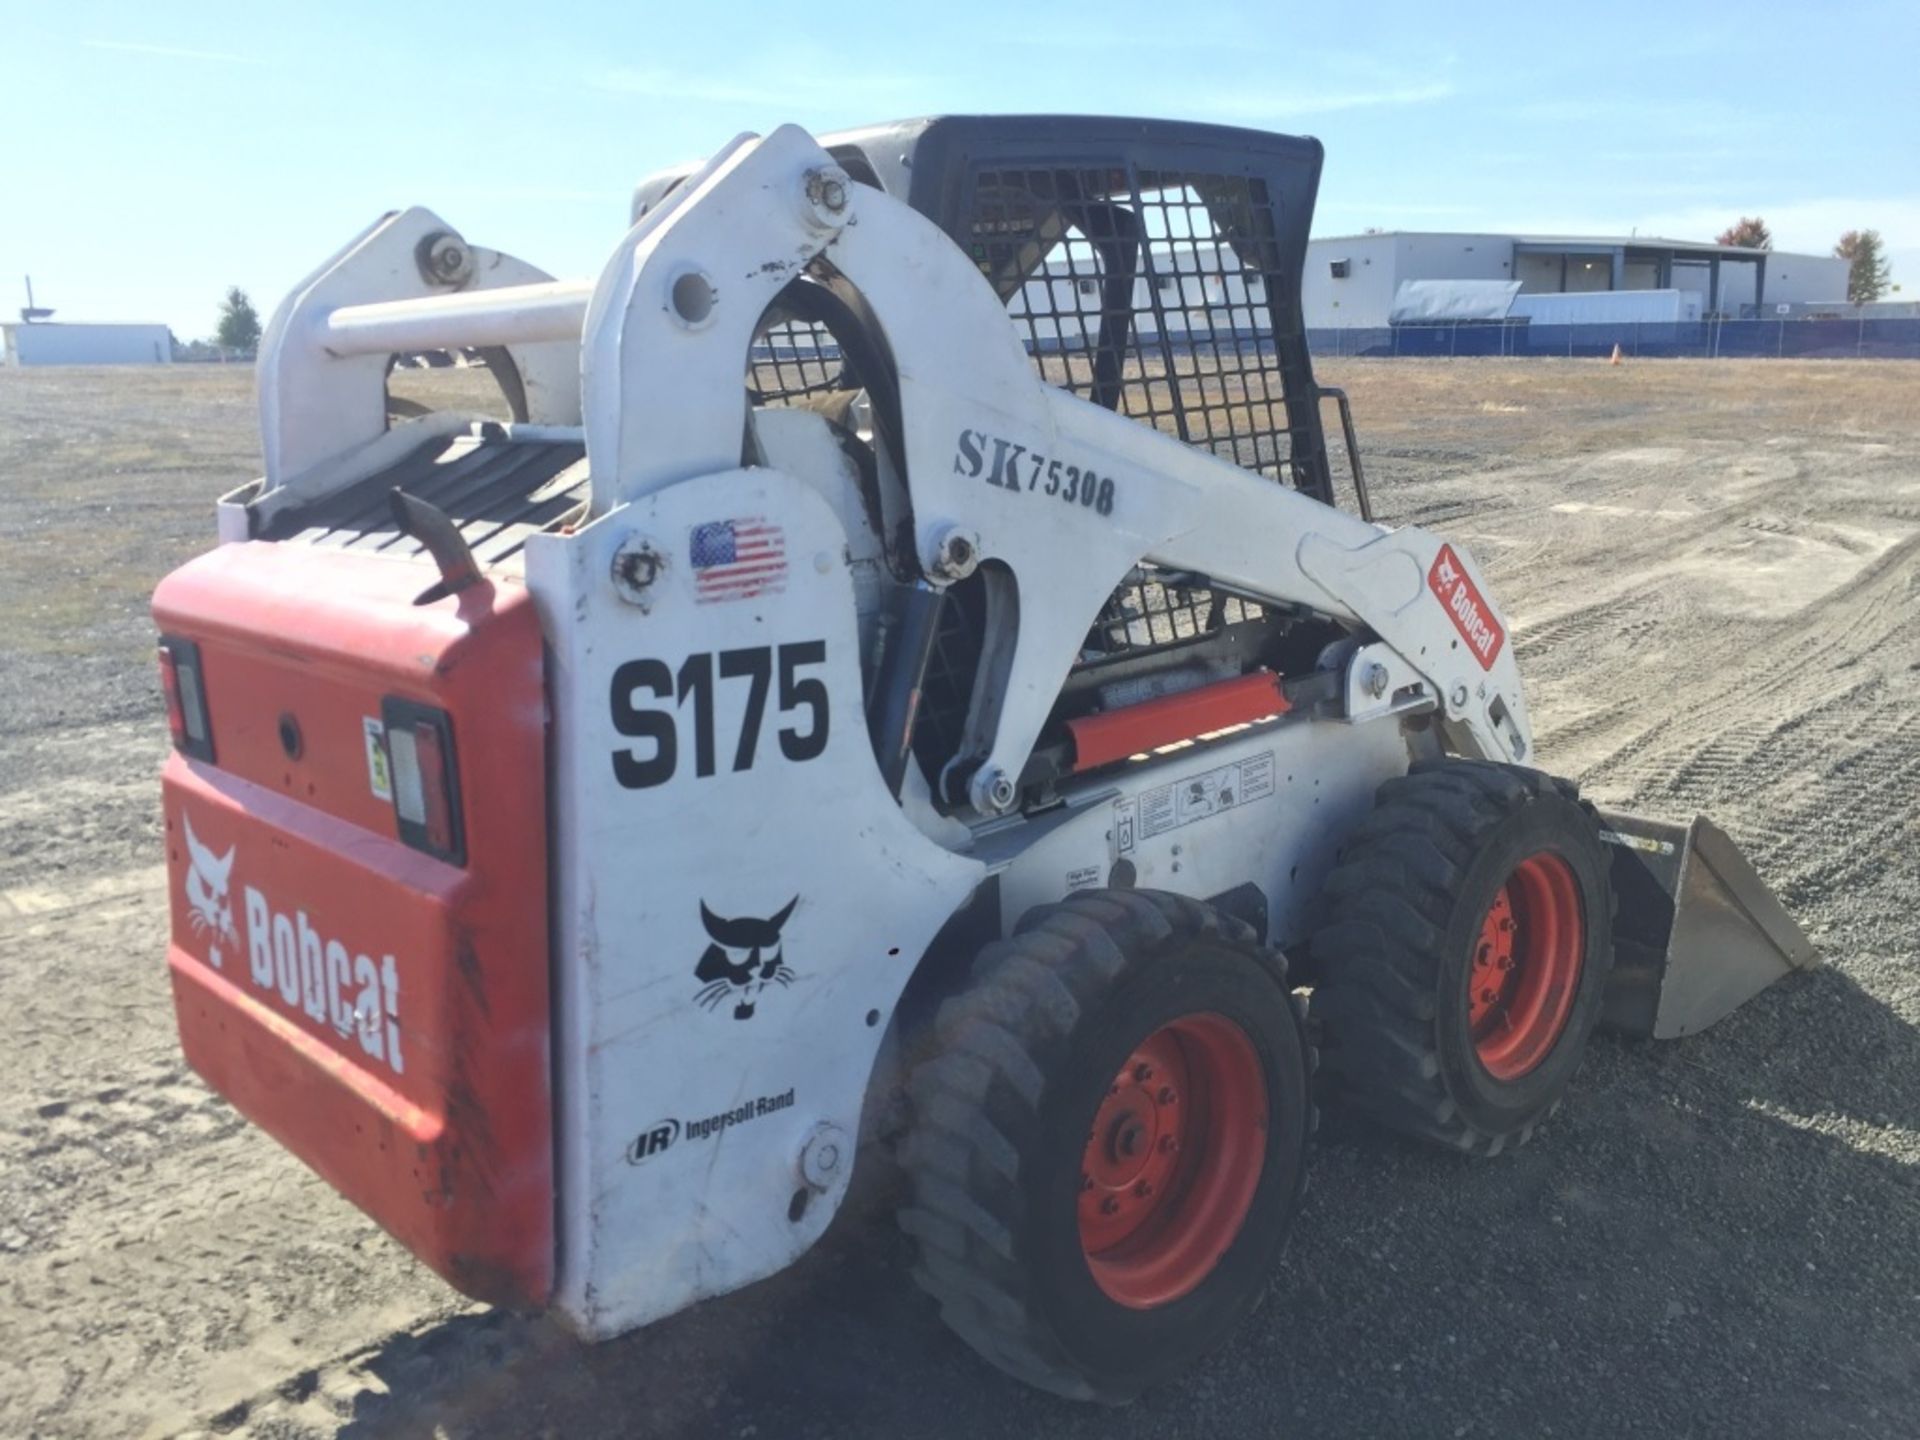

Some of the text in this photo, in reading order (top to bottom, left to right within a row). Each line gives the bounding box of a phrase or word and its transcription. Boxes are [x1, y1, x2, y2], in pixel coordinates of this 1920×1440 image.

[954, 429, 1115, 516] SK75308
[1450, 581, 1496, 658] Bobcat
[609, 639, 830, 790] S175
[244, 884, 404, 1074] Bobcat
[686, 1100, 755, 1140] Ingersoll
[756, 1087, 795, 1117] Rand
